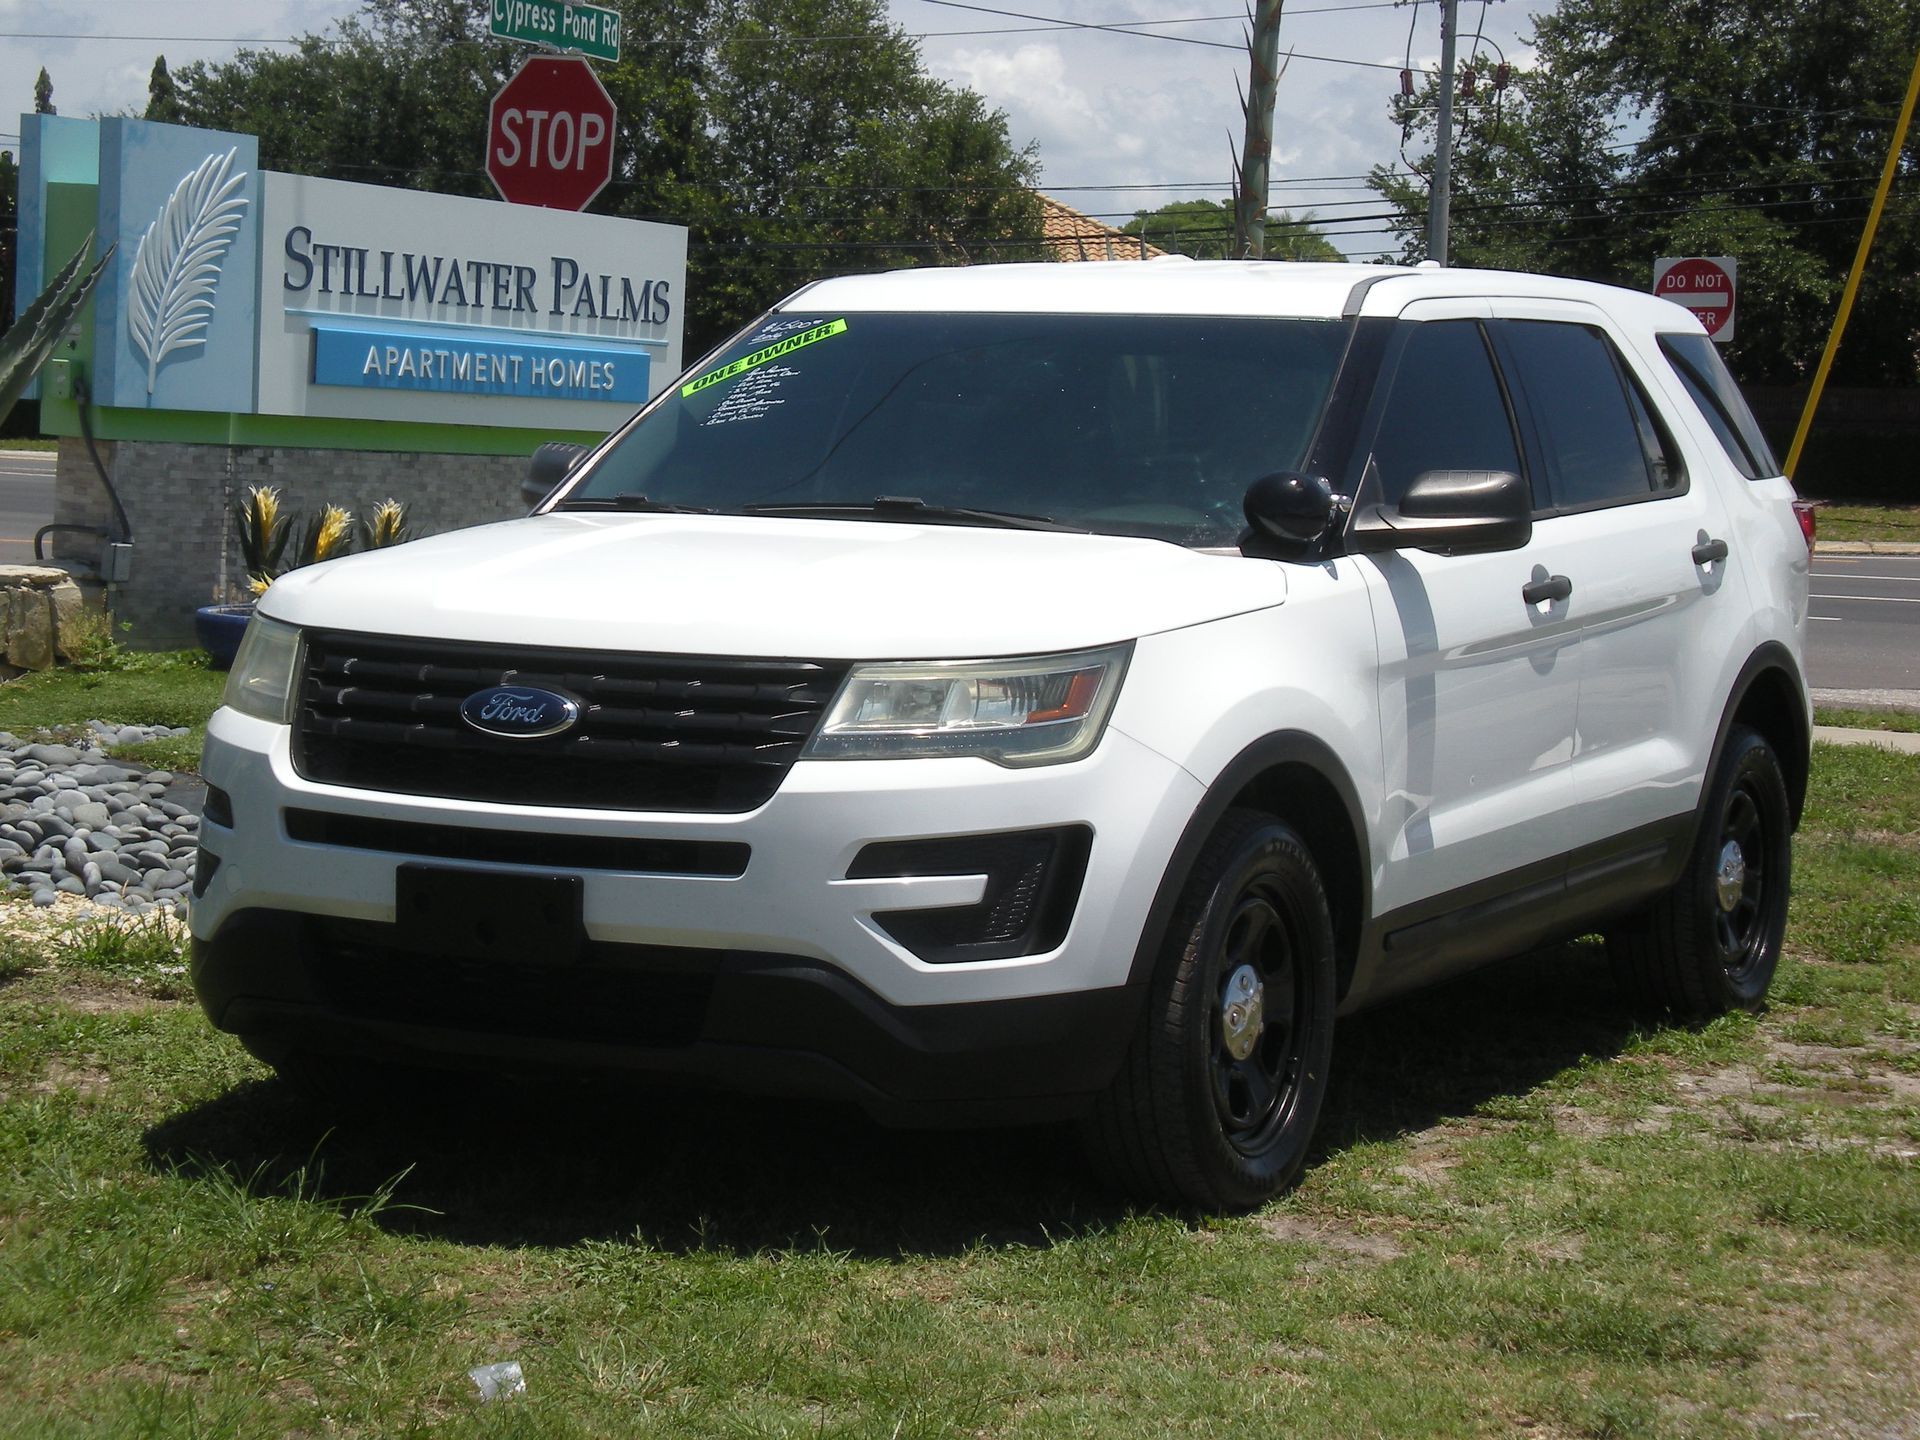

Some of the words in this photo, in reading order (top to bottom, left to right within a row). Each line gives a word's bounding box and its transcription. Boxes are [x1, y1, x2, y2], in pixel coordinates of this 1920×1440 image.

[494, 0, 556, 33] Cypress
[562, 5, 597, 42] Pond
[602, 14, 618, 48] Rd
[496, 108, 606, 171] STOP
[283, 226, 538, 313] STILLWATER
[549, 256, 671, 326] PALMS
[1666, 275, 1686, 288] DO
[1695, 274, 1724, 288] NOT
[363, 344, 523, 384] APARTMENT
[531, 358, 616, 391] HOMES
[692, 362, 741, 390] ONE
[746, 324, 834, 366] OWNER
[480, 692, 547, 723] Ford
